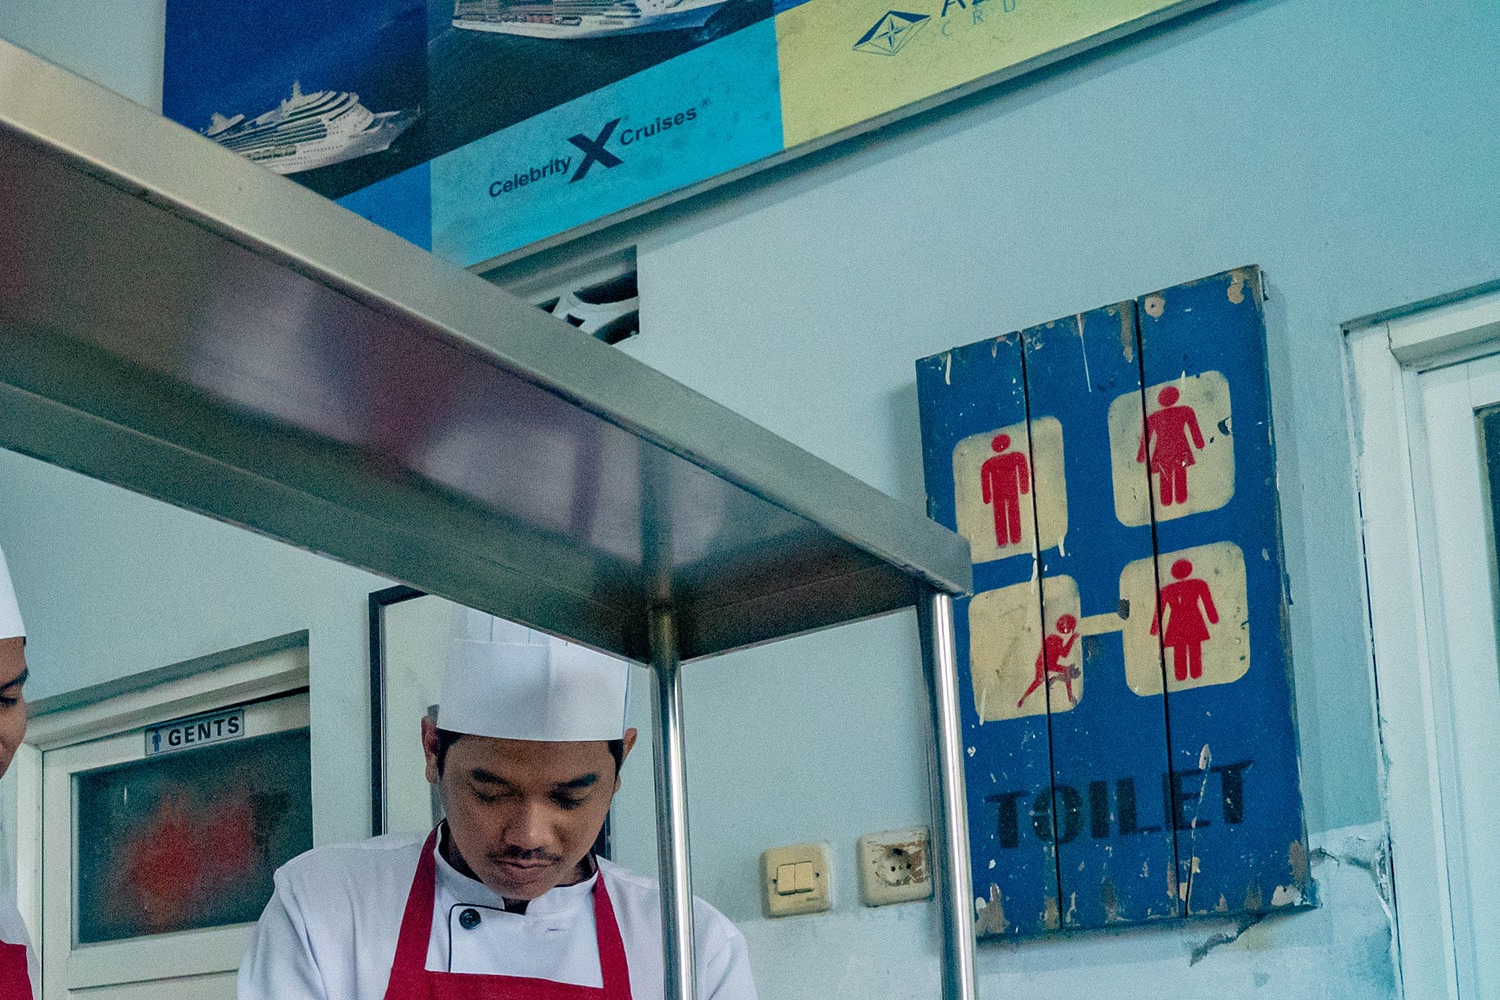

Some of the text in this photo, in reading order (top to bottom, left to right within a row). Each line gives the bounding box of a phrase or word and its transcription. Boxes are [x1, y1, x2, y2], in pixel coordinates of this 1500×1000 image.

[489, 107, 697, 198] Celebrity X Cruises
[168, 716, 240, 746] GENTS
[983, 760, 1255, 848] TOILET
